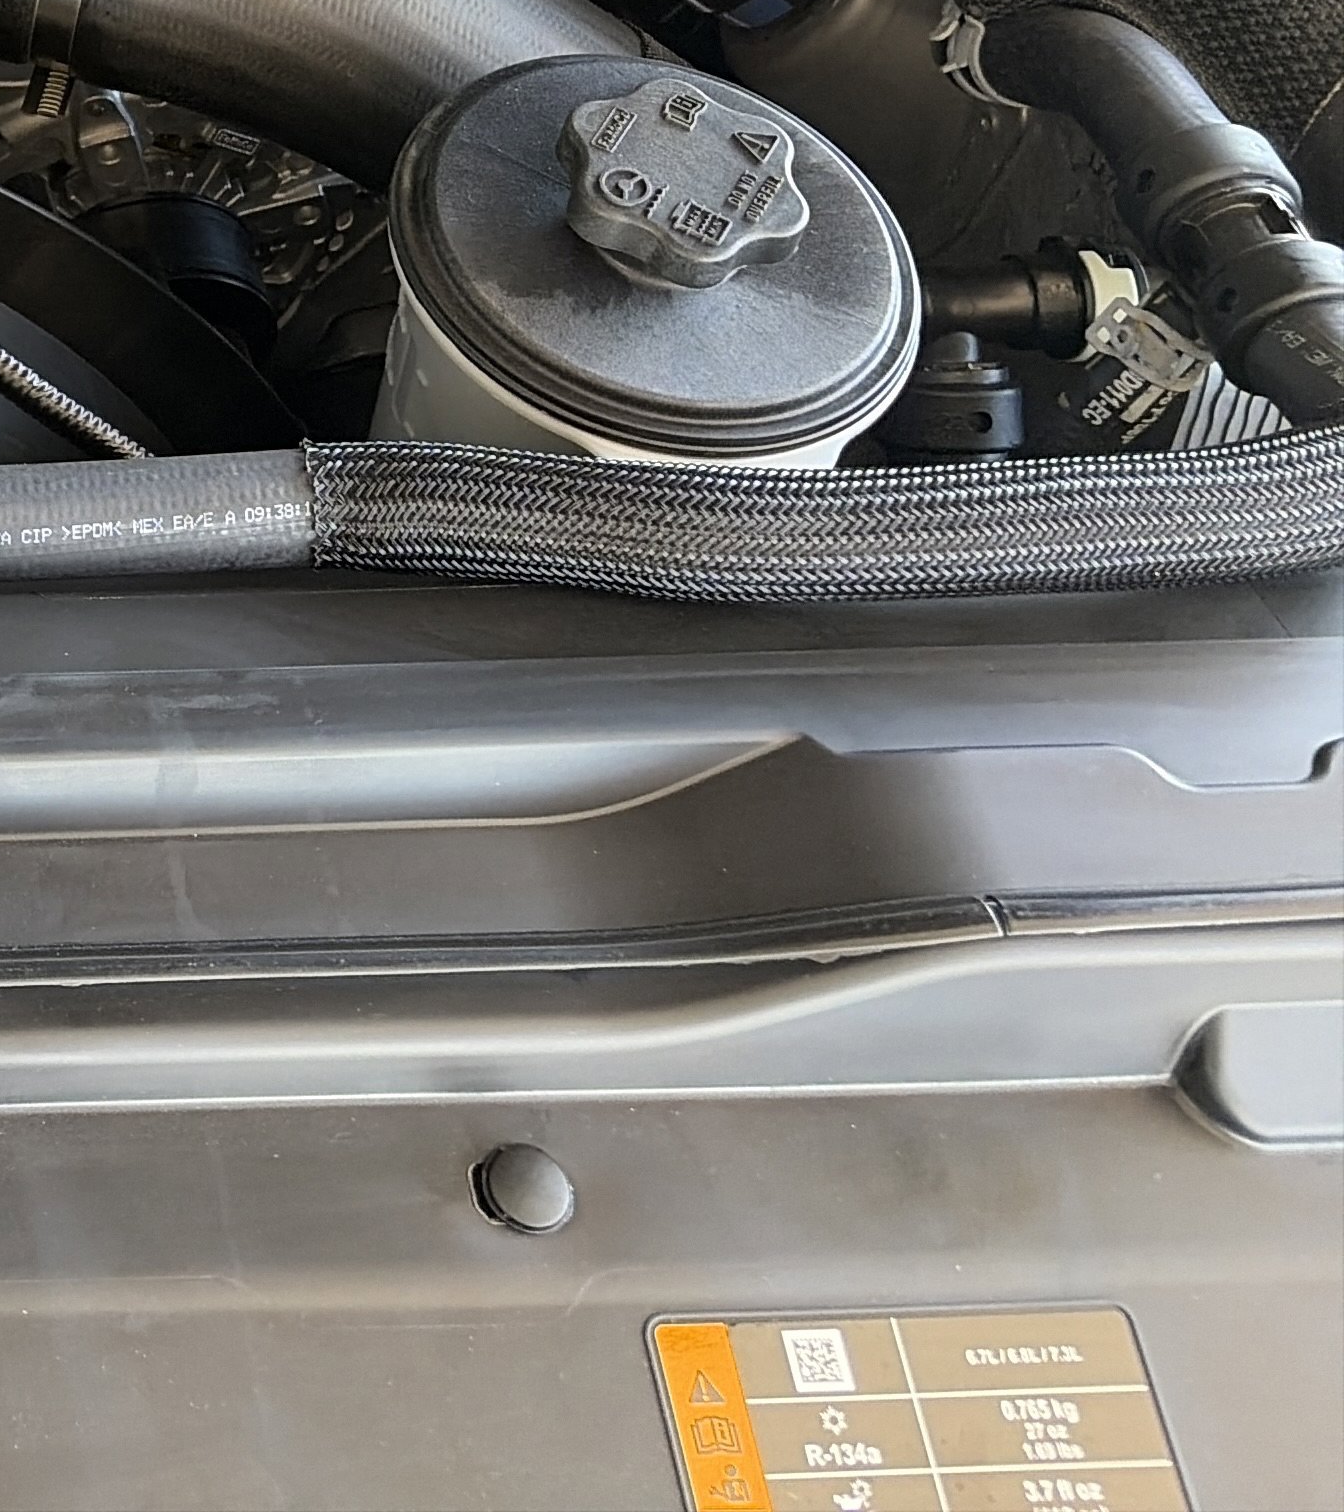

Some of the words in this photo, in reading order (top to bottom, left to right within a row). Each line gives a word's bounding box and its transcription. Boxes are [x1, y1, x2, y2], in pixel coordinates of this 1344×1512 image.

[21, 527, 54, 544] CIP
[61, 521, 123, 541] >EPDM<
[132, 517, 164, 534] MEX
[173, 511, 215, 531] EA/E
[224, 510, 237, 526] A
[244, 500, 312, 523] 09:38:1
[805, 1442, 883, 1467] R-134a
